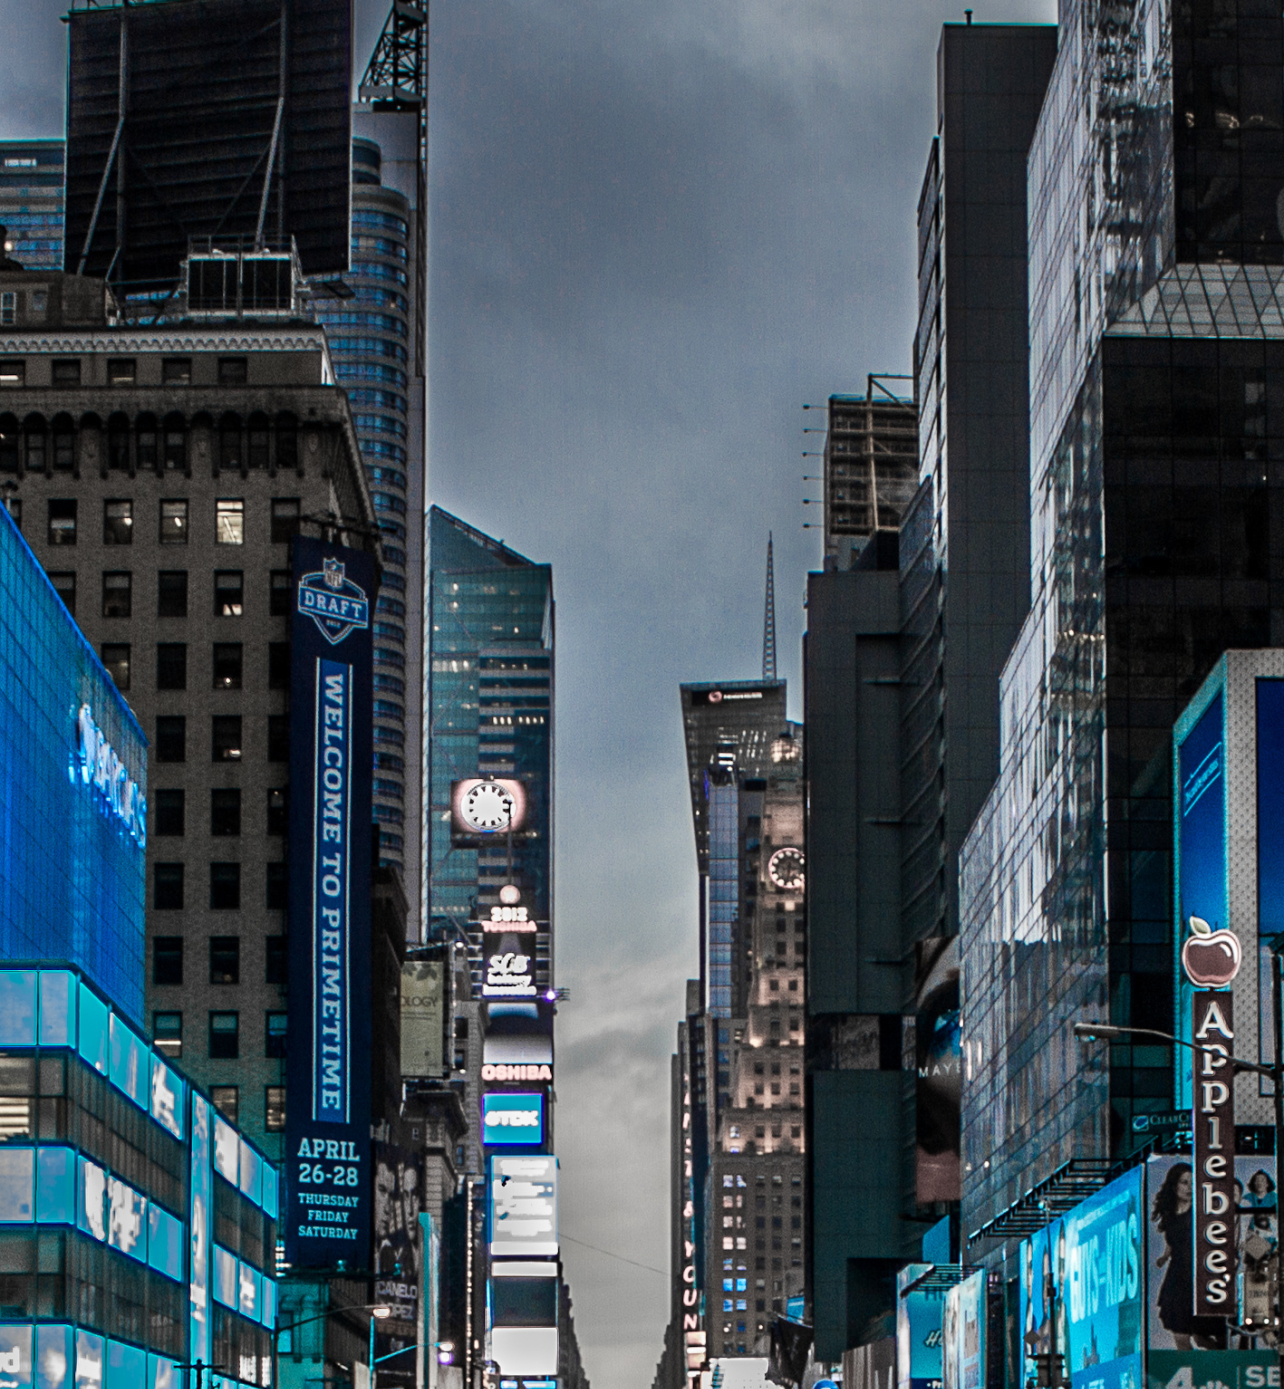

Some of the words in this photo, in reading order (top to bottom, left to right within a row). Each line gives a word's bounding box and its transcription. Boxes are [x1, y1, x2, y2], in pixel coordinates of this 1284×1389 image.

[305, 590, 362, 618] DRAFT
[323, 673, 344, 844] WELCOME
[322, 853, 342, 897] TO
[321, 907, 342, 1109] PRIMETIME
[297, 1137, 360, 1162] APRIL
[1195, 1001, 1234, 1303] Applebee's
[298, 1163, 359, 1187] 26-28
[298, 1192, 360, 1208] THURSDAY
[307, 1209, 350, 1223] FRIDAY
[298, 1225, 358, 1240] SATURDAY
[1105, 1212, 1139, 1308] KIDS
